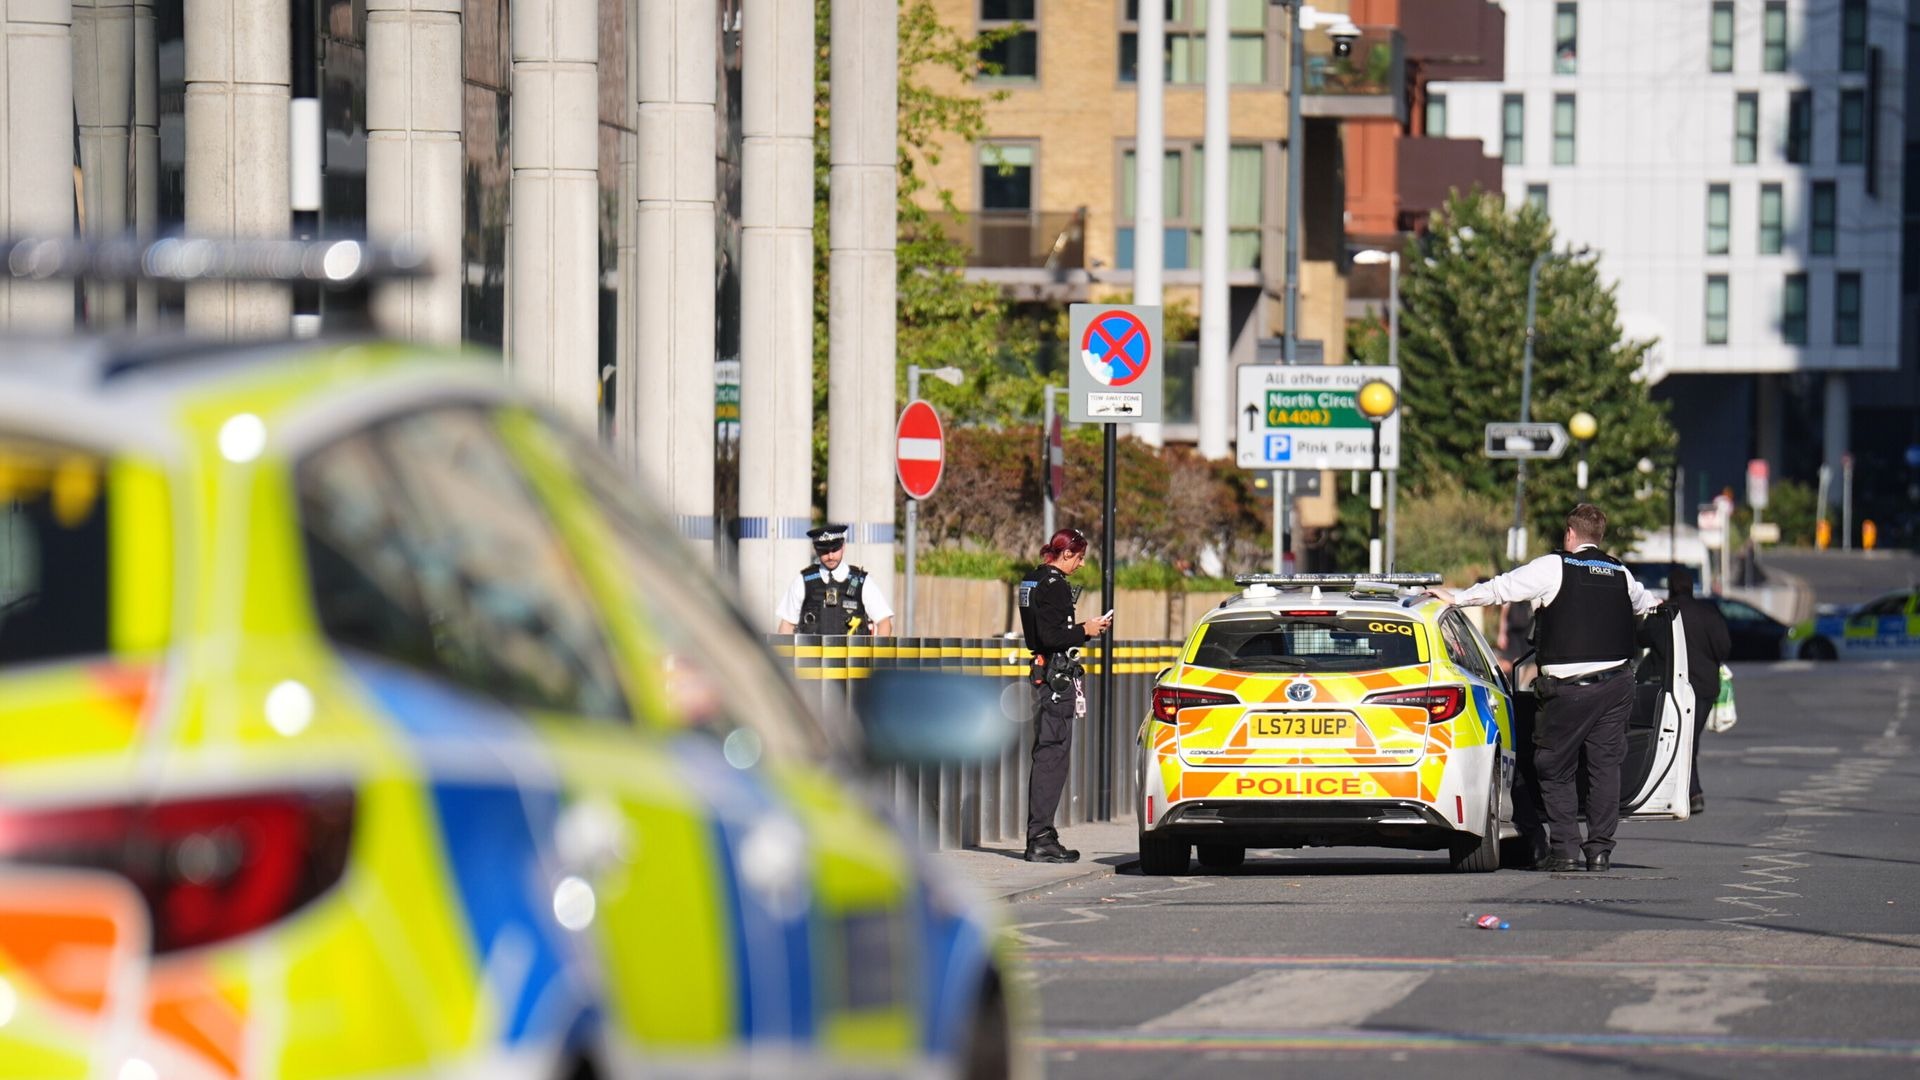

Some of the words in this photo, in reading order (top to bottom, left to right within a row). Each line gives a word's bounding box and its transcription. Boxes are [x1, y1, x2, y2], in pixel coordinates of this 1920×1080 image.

[1266, 372, 1285, 384] All
[1290, 372, 1330, 384] other
[1335, 373, 1384, 385] rout
[1269, 393, 1314, 408] North
[1317, 393, 1357, 408] Circu
[1269, 436, 1289, 461] P
[1297, 440, 1328, 454] Pink
[1335, 440, 1391, 456] Parkg
[1591, 566, 1612, 575] POLICE
[1368, 622, 1413, 636] QCQ
[1258, 718, 1306, 735] LS73
[1311, 718, 1347, 735] UEP
[1236, 778, 1361, 795] POLICE
